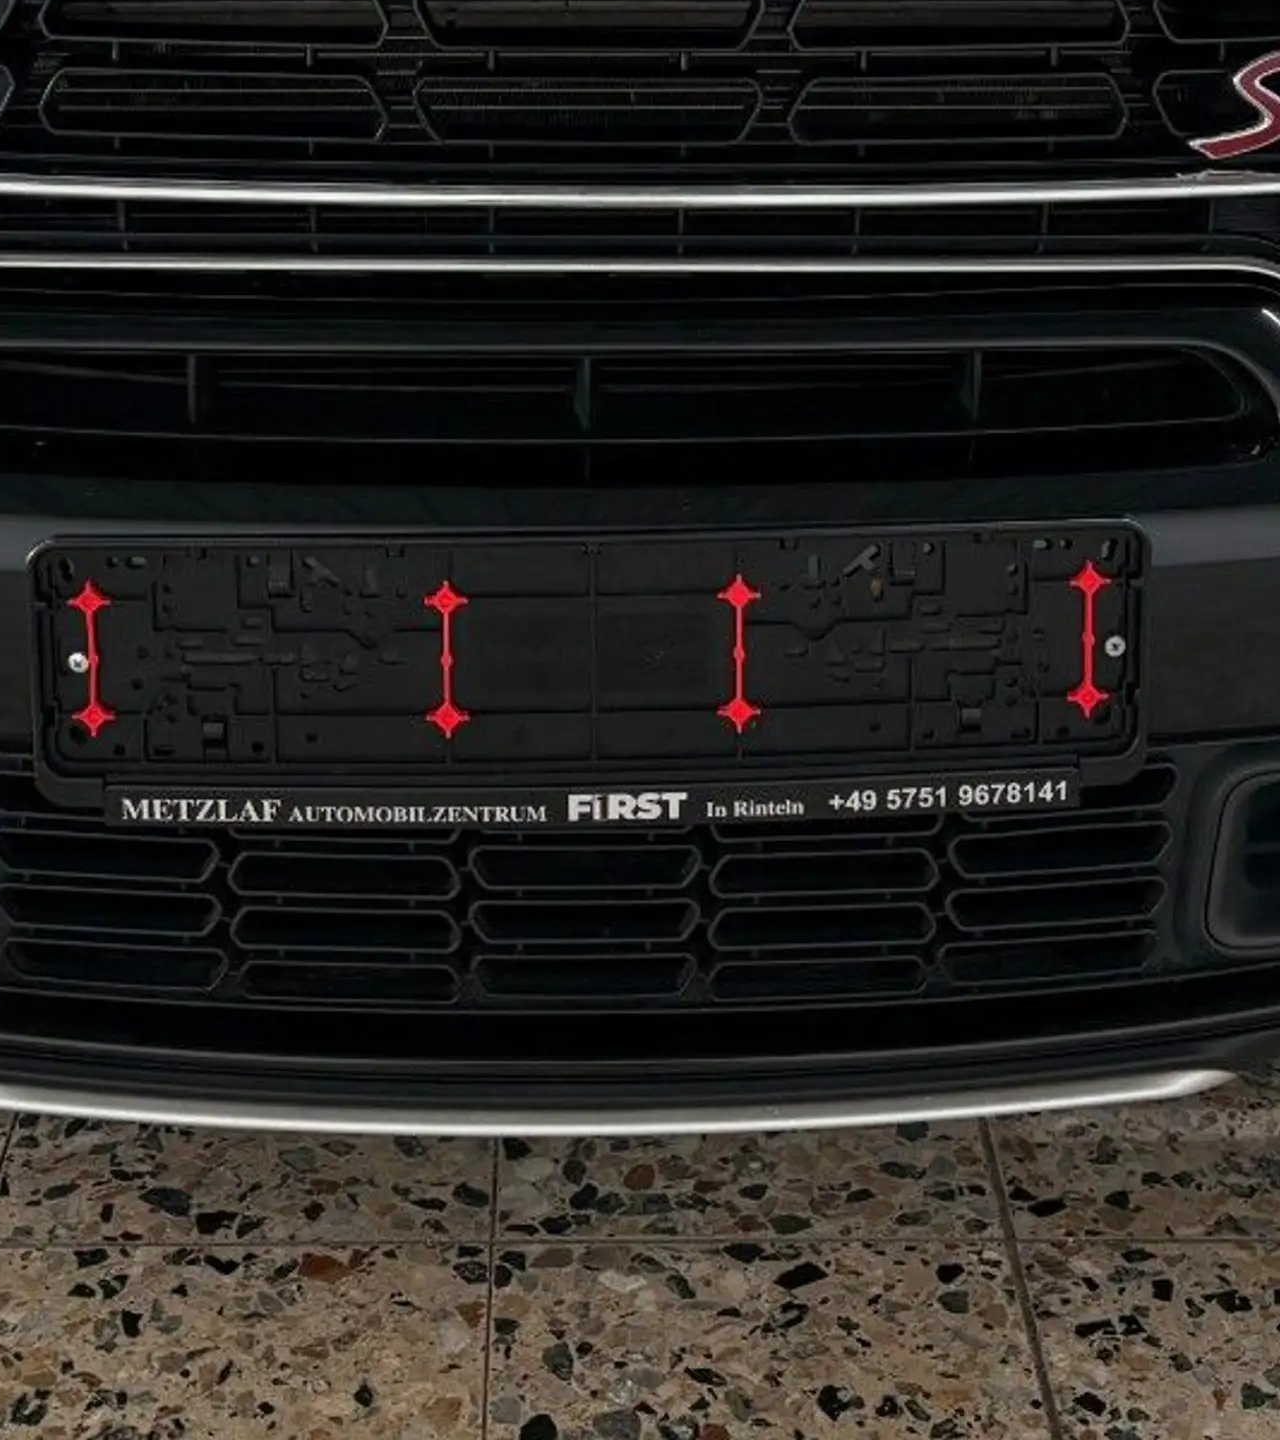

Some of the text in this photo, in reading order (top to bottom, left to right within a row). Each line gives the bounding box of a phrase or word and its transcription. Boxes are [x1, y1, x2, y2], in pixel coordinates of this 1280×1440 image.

[121, 798, 282, 822] METZLAF
[288, 805, 548, 823] AUTOMOBILZENTRUM
[706, 801, 727, 817] In
[733, 798, 805, 817] Rinteln
[829, 790, 877, 811] +49
[886, 786, 947, 809] 5751
[958, 780, 1067, 806] 9678141
